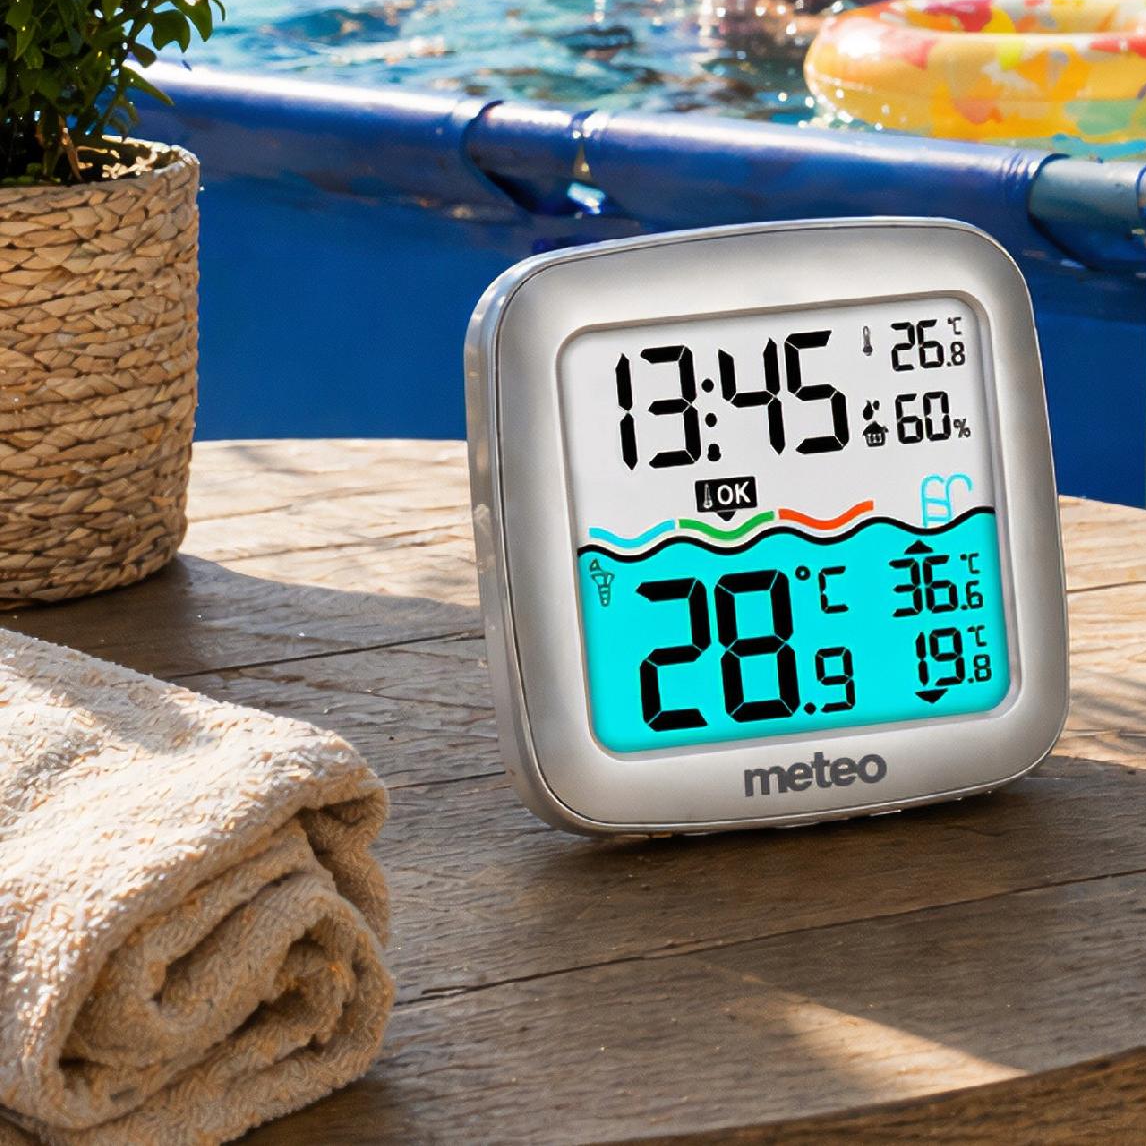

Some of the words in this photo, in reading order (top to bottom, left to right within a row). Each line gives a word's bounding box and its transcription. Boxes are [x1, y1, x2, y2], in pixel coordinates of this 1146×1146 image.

[615, 330, 849, 470] 13:45
[717, 483, 751, 504] OK
[743, 751, 887, 797] meteo
